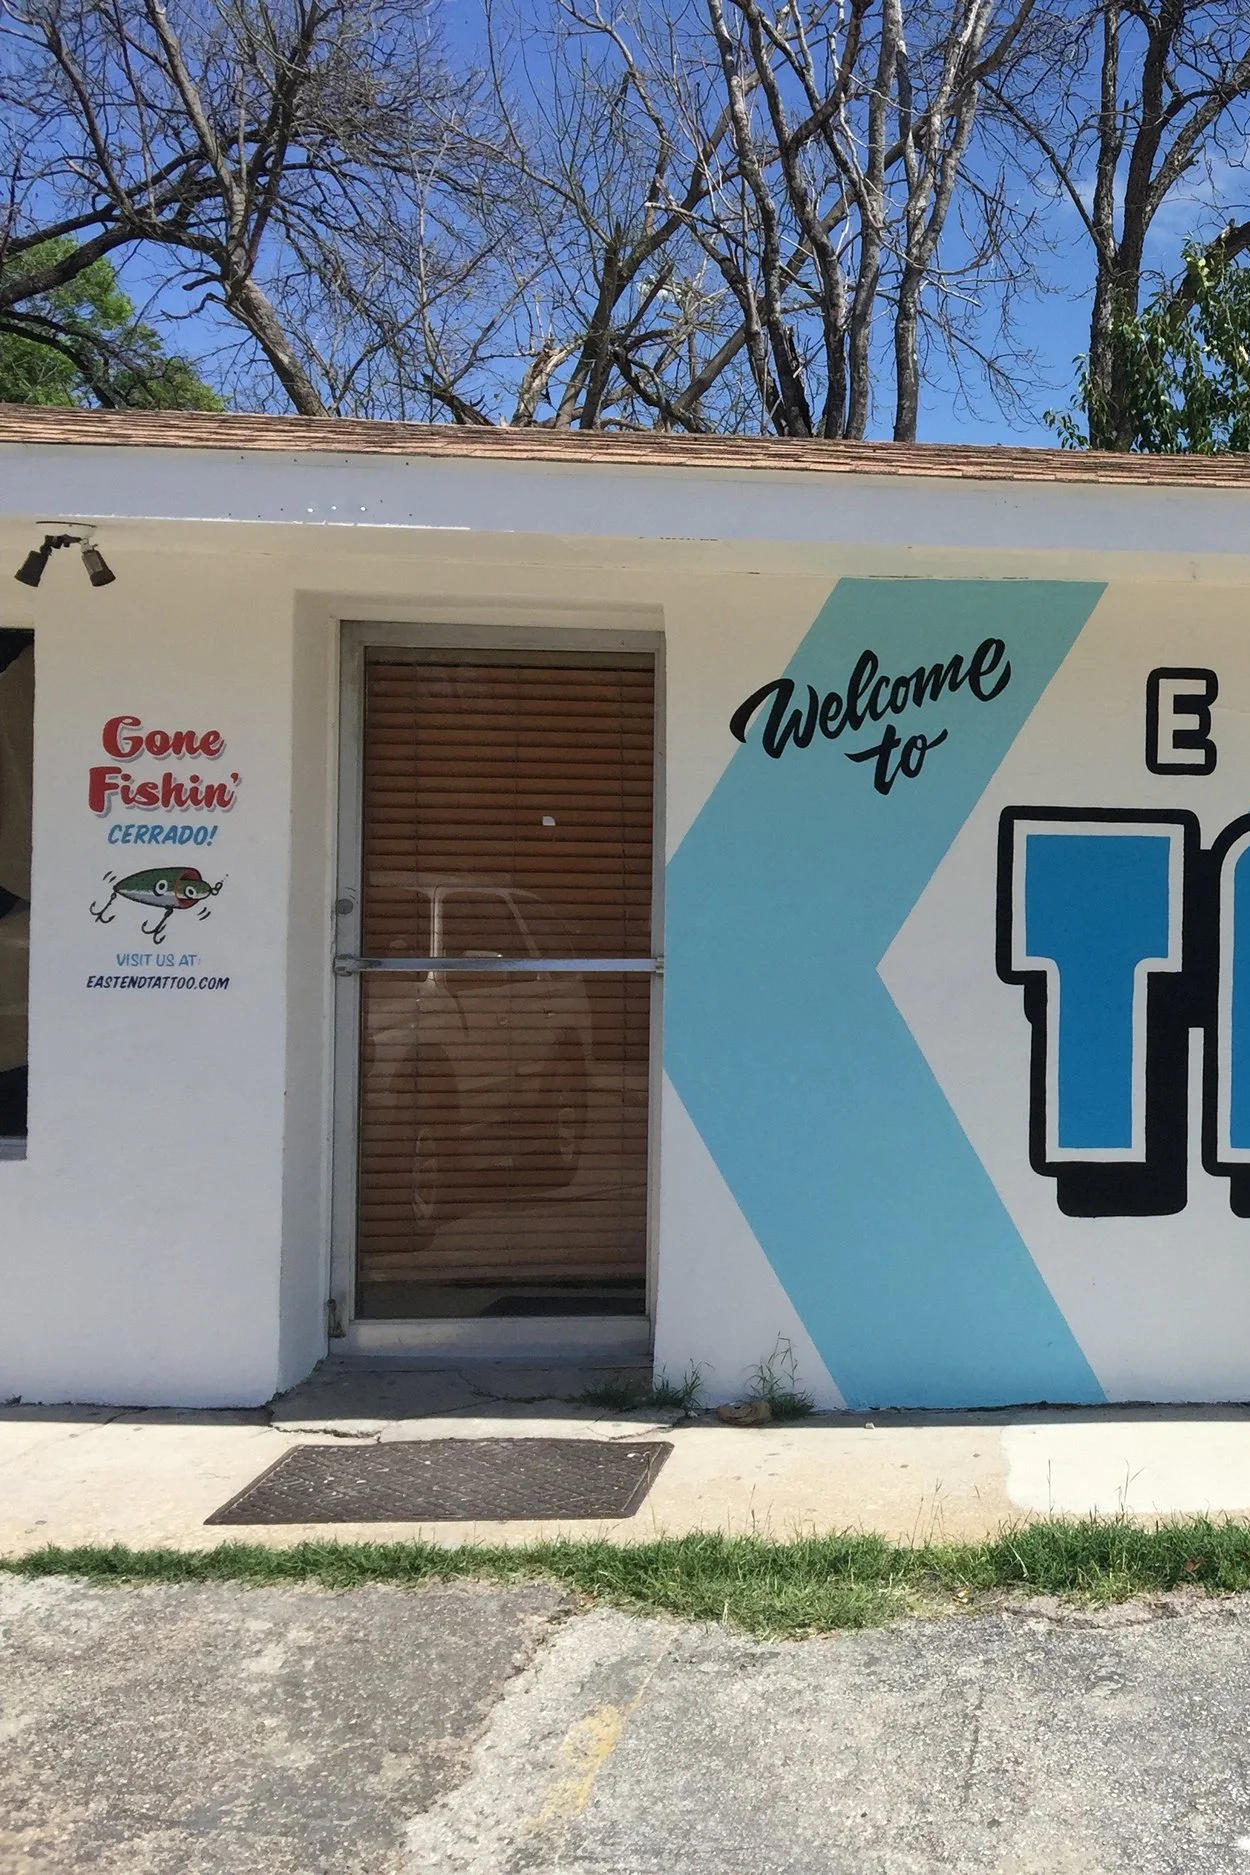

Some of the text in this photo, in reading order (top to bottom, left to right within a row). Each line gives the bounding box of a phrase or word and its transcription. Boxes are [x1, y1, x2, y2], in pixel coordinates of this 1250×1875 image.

[729, 638, 1011, 759] Welcome
[102, 715, 226, 760] Gone
[844, 724, 948, 796] to
[88, 766, 242, 819] Fishin'
[107, 824, 218, 846] CERRADO!
[86, 975, 230, 991] EASTENDTATTOO.COM
[116, 953, 153, 968] VISIT
[156, 954, 175, 968] US
